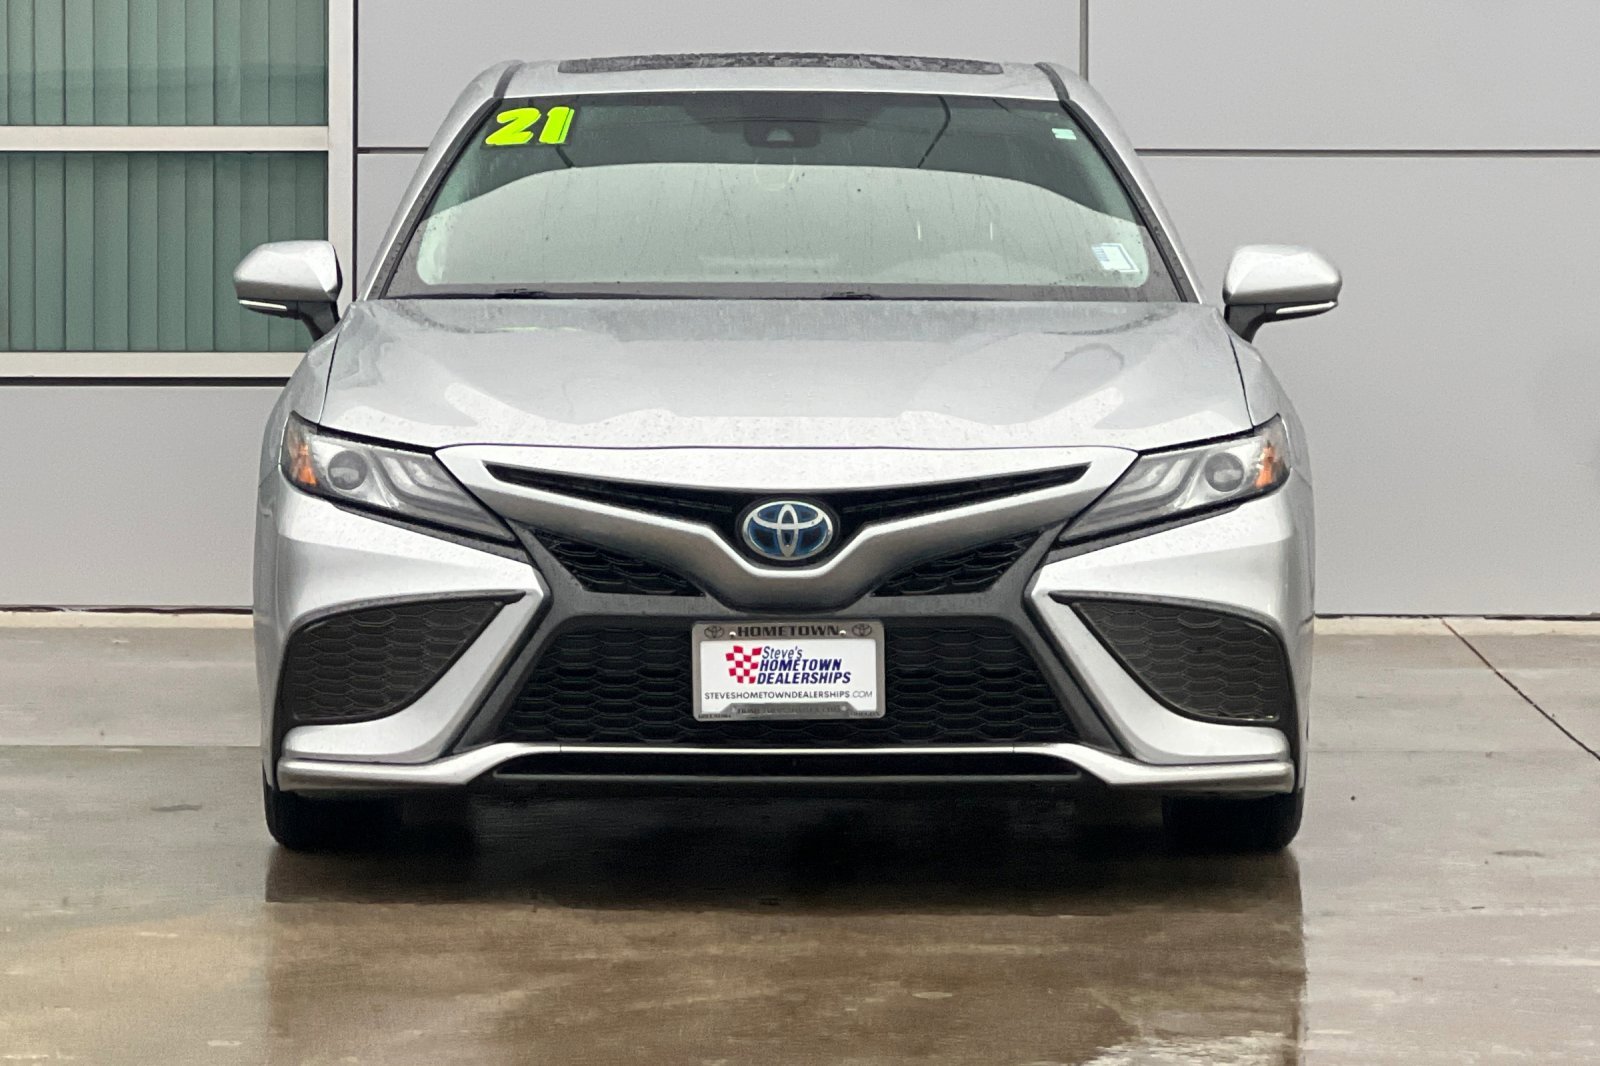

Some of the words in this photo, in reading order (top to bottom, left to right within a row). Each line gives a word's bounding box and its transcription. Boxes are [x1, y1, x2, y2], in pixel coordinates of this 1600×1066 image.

[485, 106, 575, 146] 21
[737, 625, 840, 637] HOMETOWN
[762, 645, 803, 660] Steve's
[760, 659, 842, 672] HOMETOWN
[757, 672, 852, 685] DEALERSHIPS
